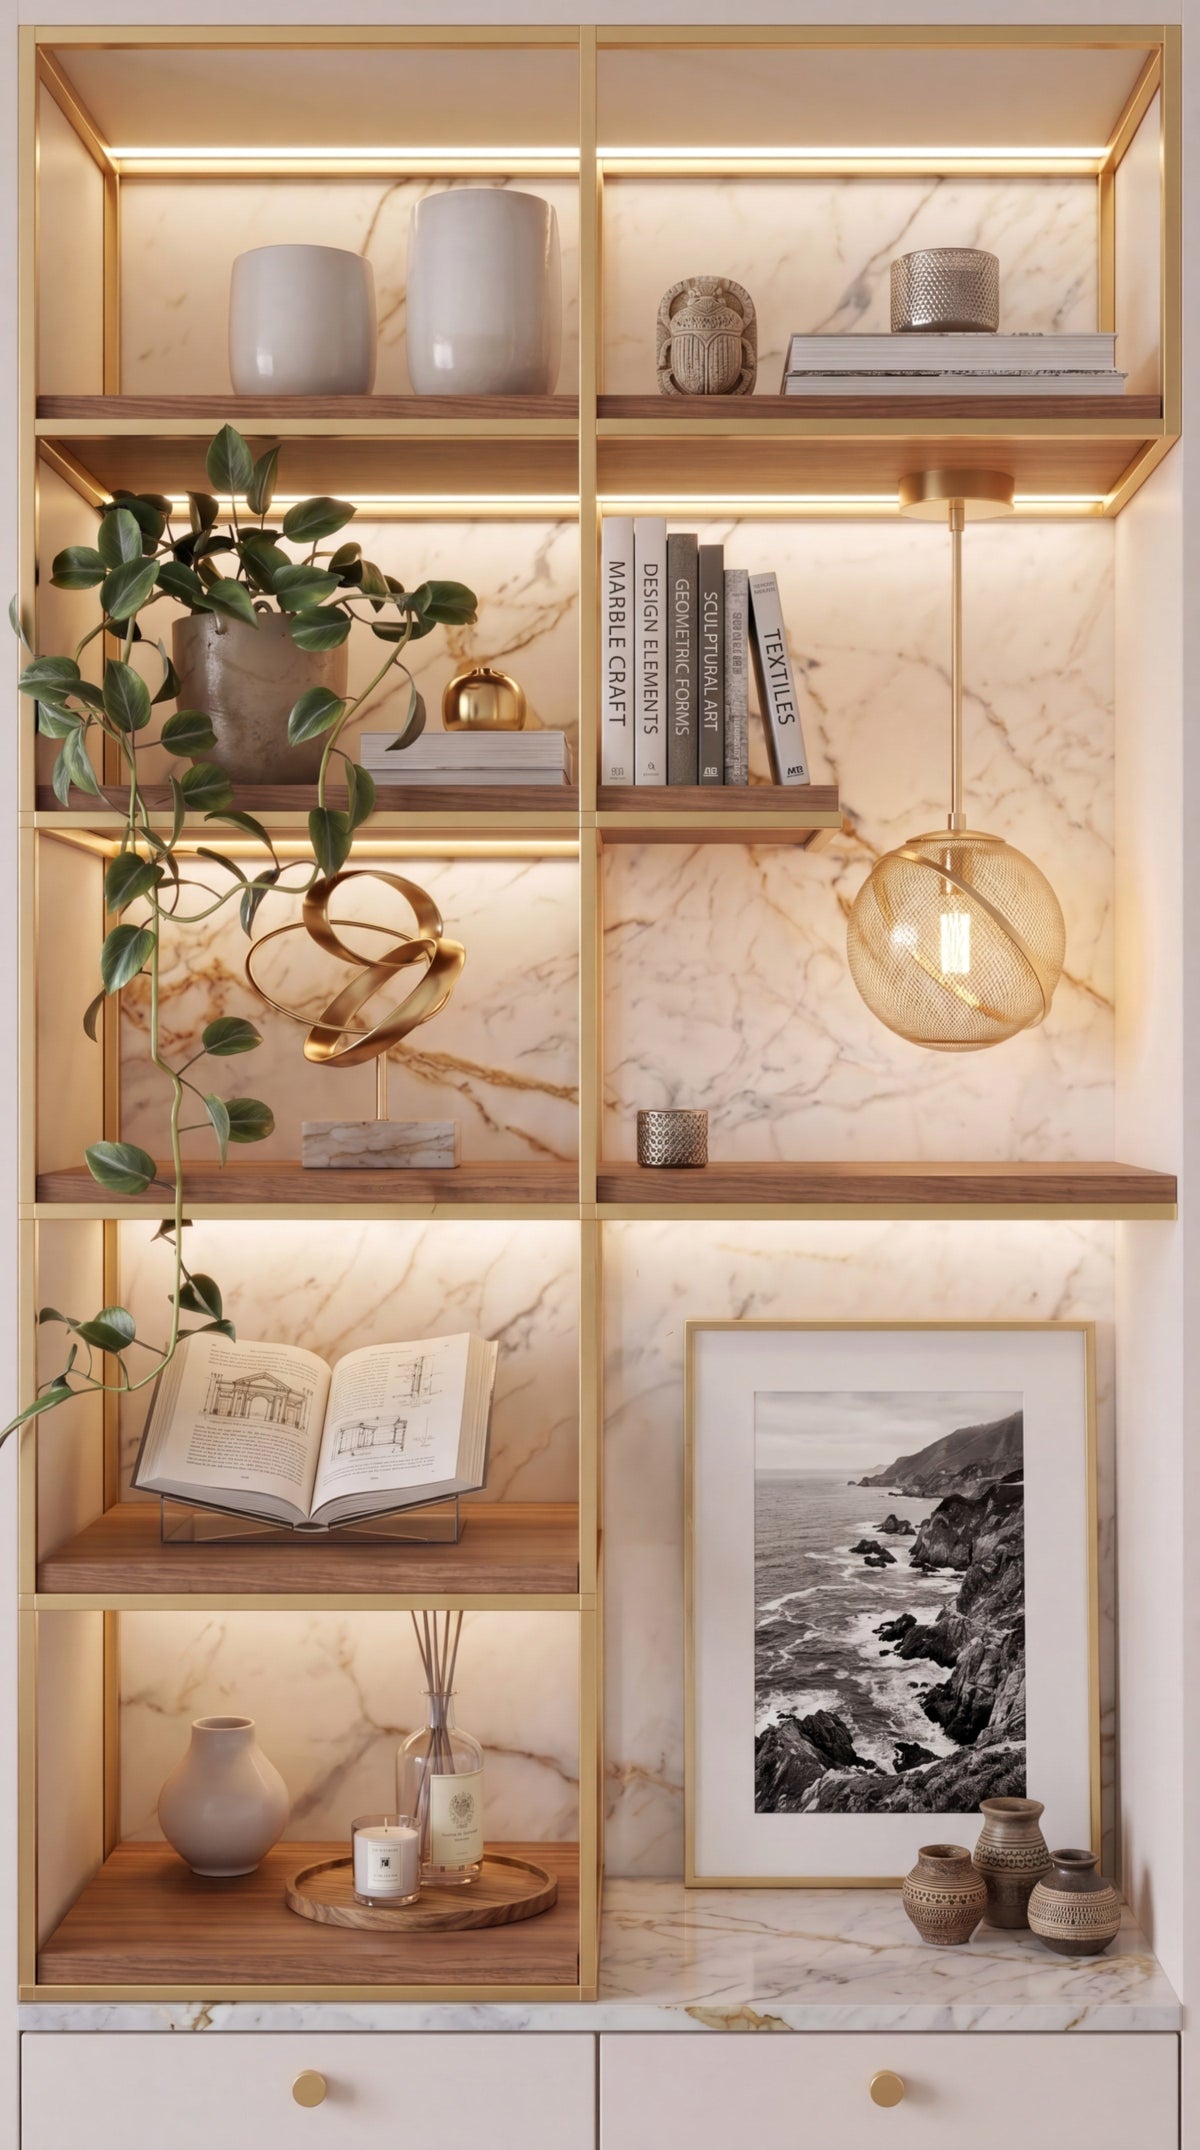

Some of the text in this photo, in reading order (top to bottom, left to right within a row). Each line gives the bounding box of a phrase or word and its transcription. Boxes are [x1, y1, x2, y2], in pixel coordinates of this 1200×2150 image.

[608, 561, 626, 727] MARBLE CRAFT
[643, 563, 659, 734] DESIGN ELEMENTS
[675, 578, 690, 736] GEOMETRIC FORMS
[703, 592, 718, 732] SCULPTURAL ART
[763, 628, 795, 726] TEXTILES
